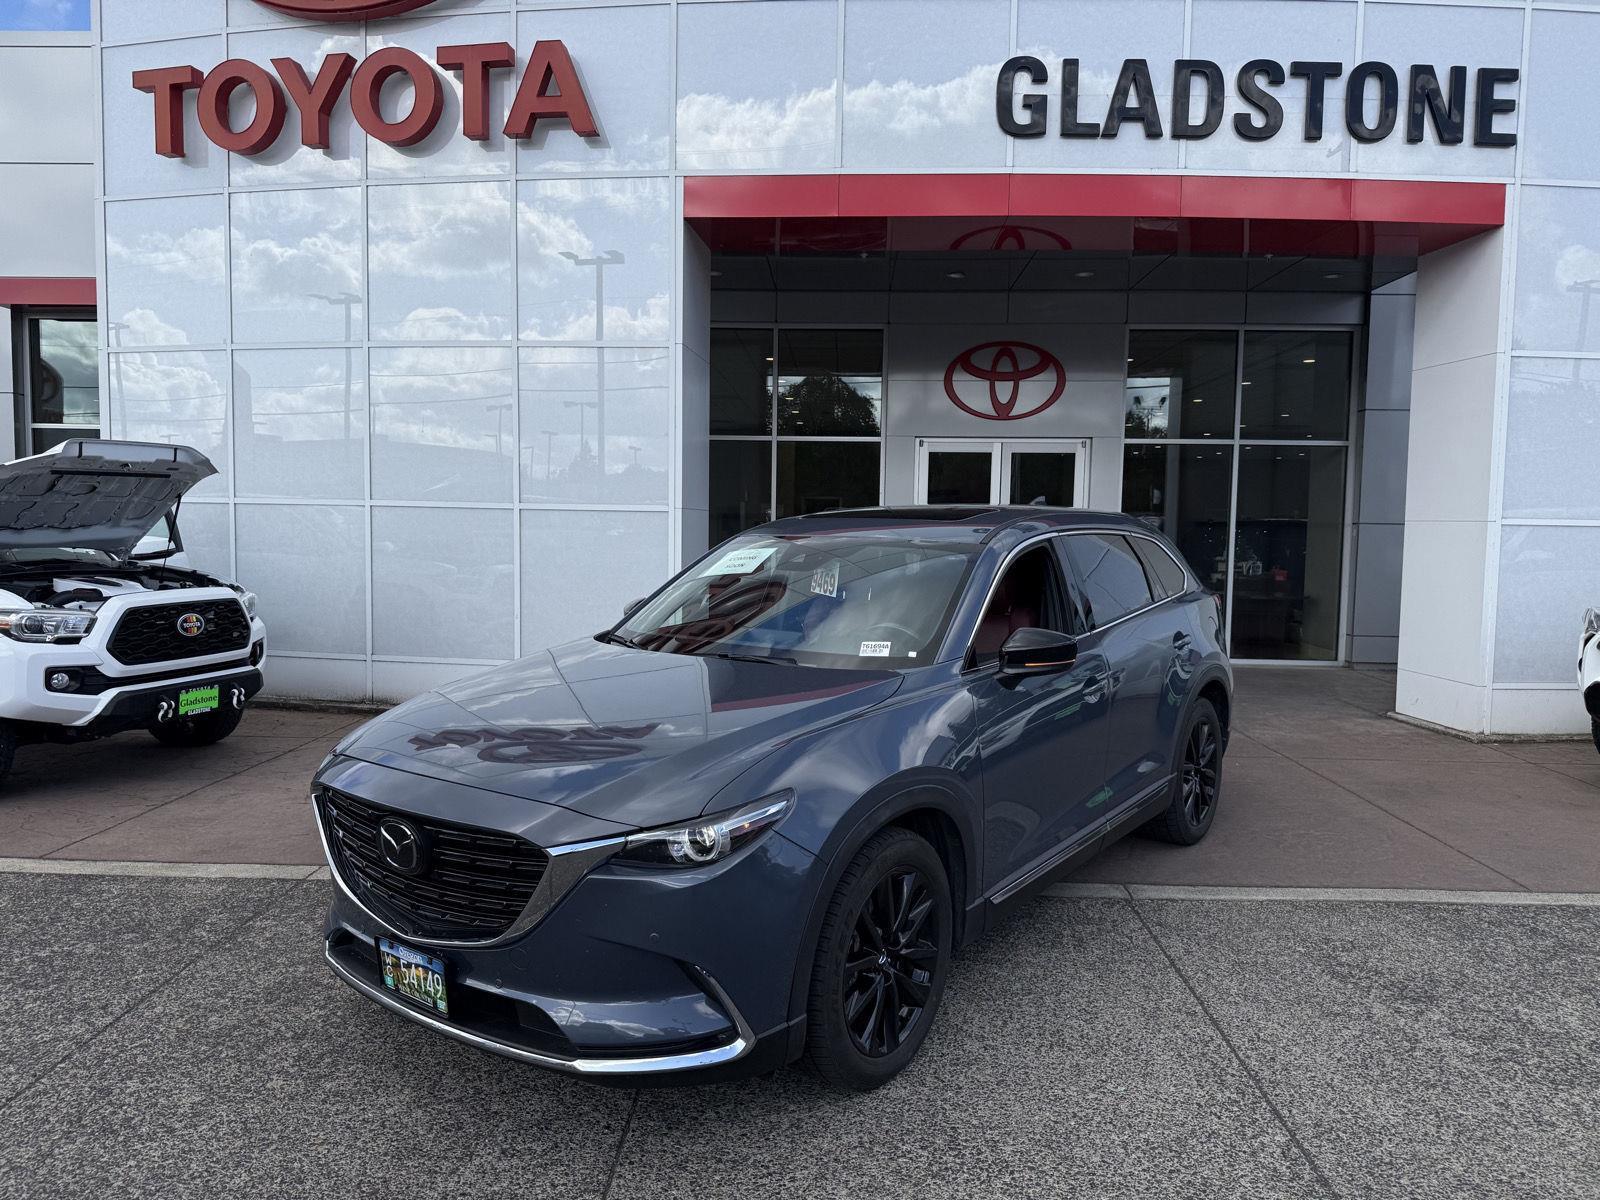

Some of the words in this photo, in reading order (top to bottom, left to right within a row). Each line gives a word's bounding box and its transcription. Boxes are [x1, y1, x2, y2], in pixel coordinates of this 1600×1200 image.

[133, 40, 601, 158] TOYOTA
[996, 56, 1519, 147] GLADSTONE
[811, 572, 836, 595] 9469
[180, 696, 217, 707] Gladstone
[400, 958, 443, 998] 54149
